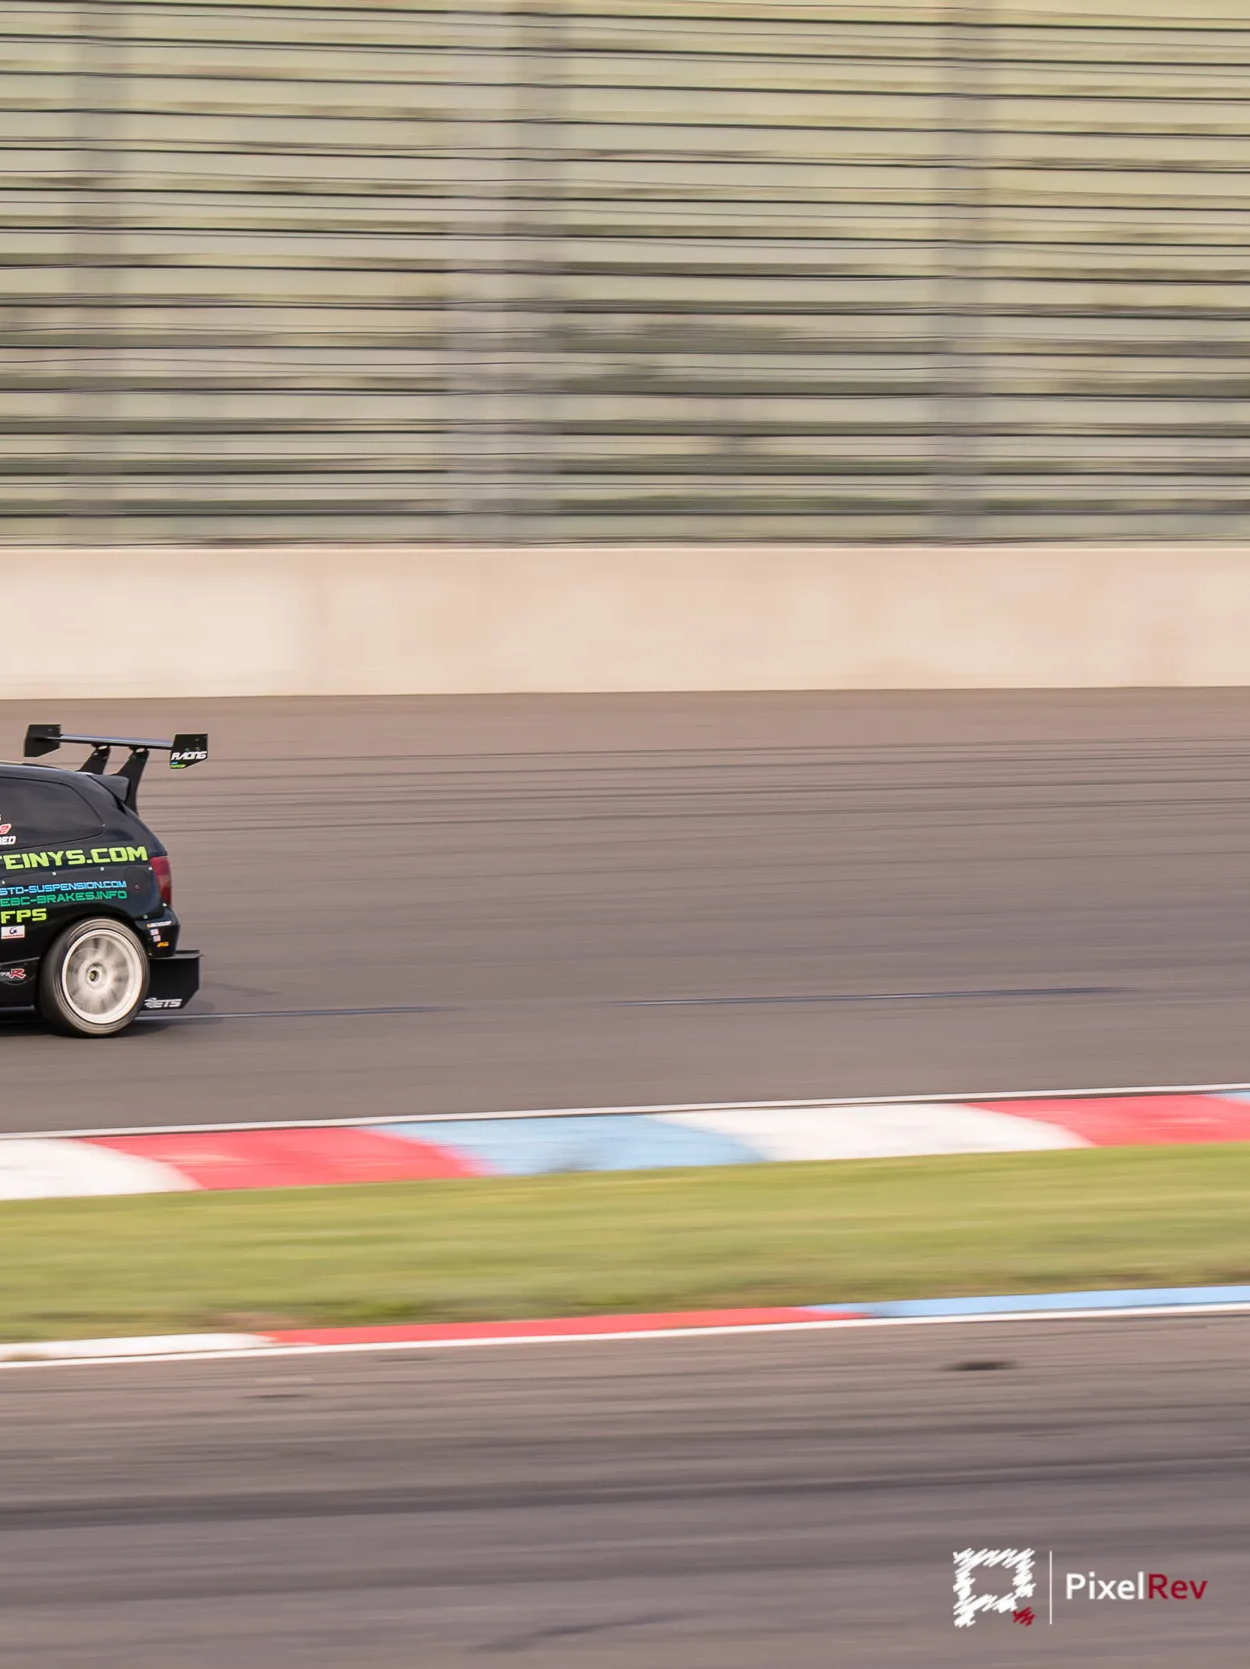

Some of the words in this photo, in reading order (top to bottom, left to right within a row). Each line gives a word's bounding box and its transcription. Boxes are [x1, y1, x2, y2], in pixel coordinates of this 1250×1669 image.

[171, 751, 207, 760] RACING
[0, 890, 127, 907] EBC-BRAKES.INFO
[1, 908, 47, 924] FPS
